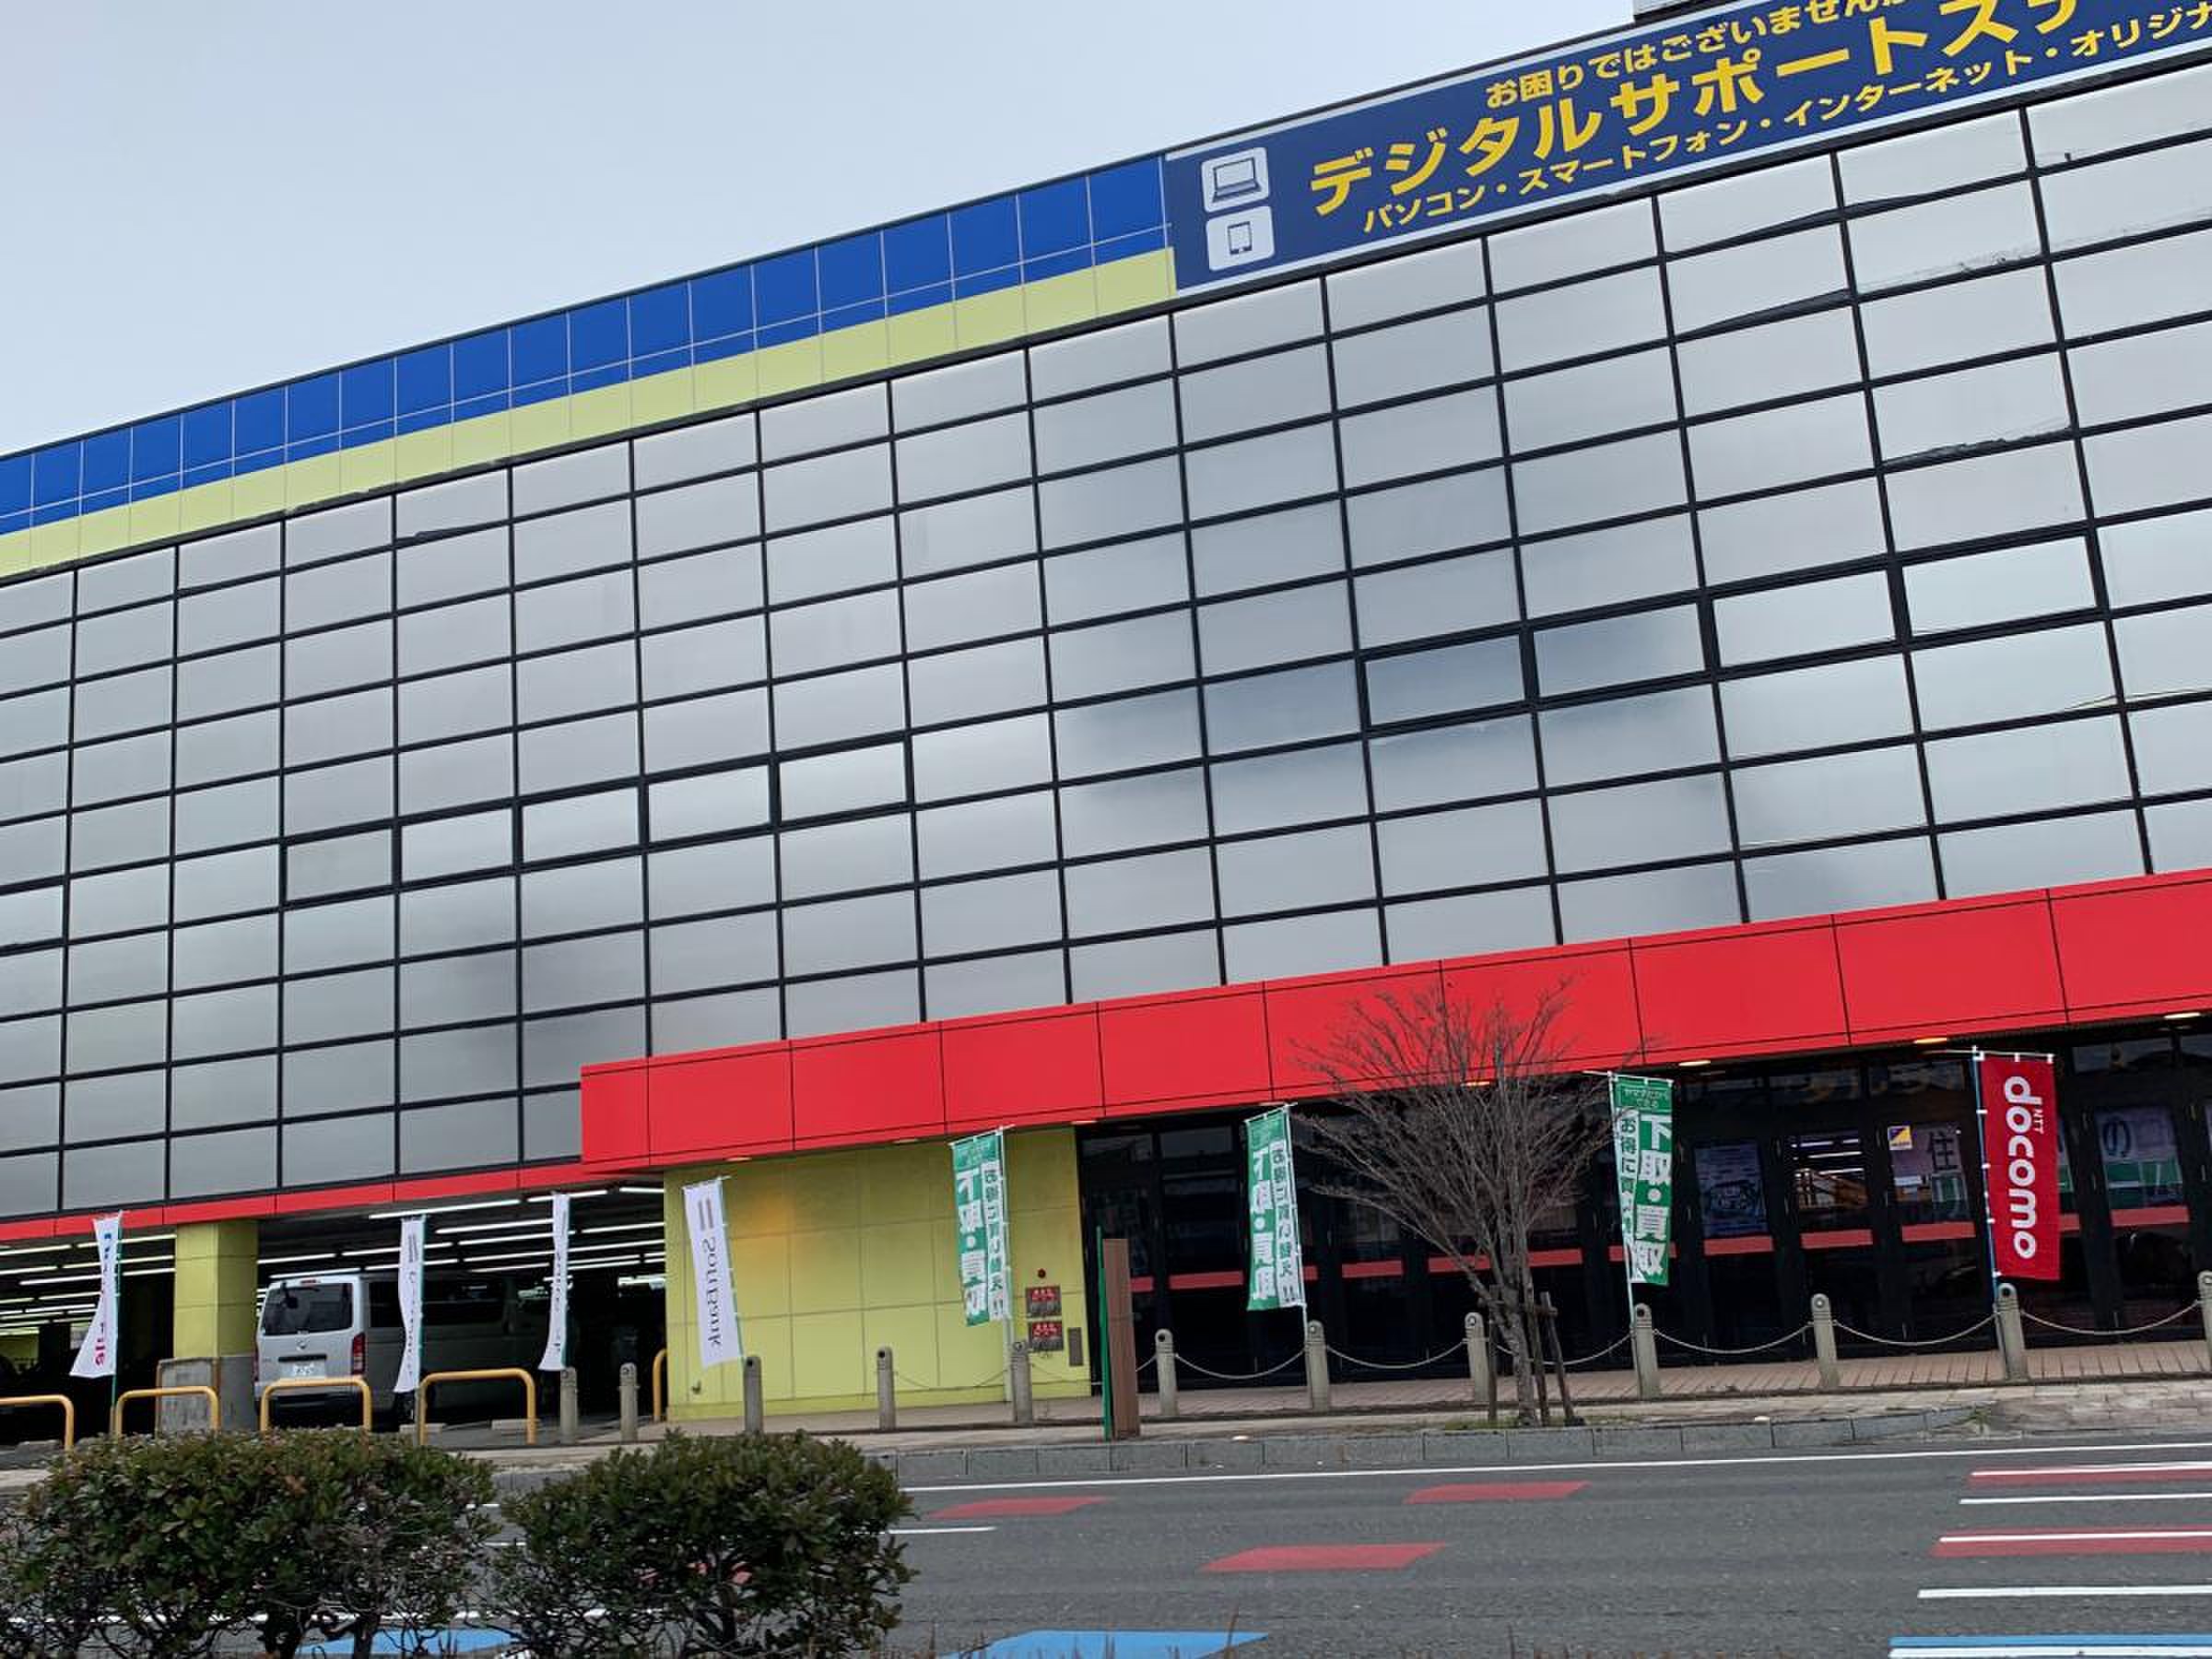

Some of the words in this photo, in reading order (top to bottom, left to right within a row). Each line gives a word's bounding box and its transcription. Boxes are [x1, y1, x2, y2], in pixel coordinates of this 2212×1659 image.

[1486, 0, 1905, 109] お困りではございません
[2004, 1077, 2042, 1259] docomo
[2033, 1108, 2044, 1134] NTT
